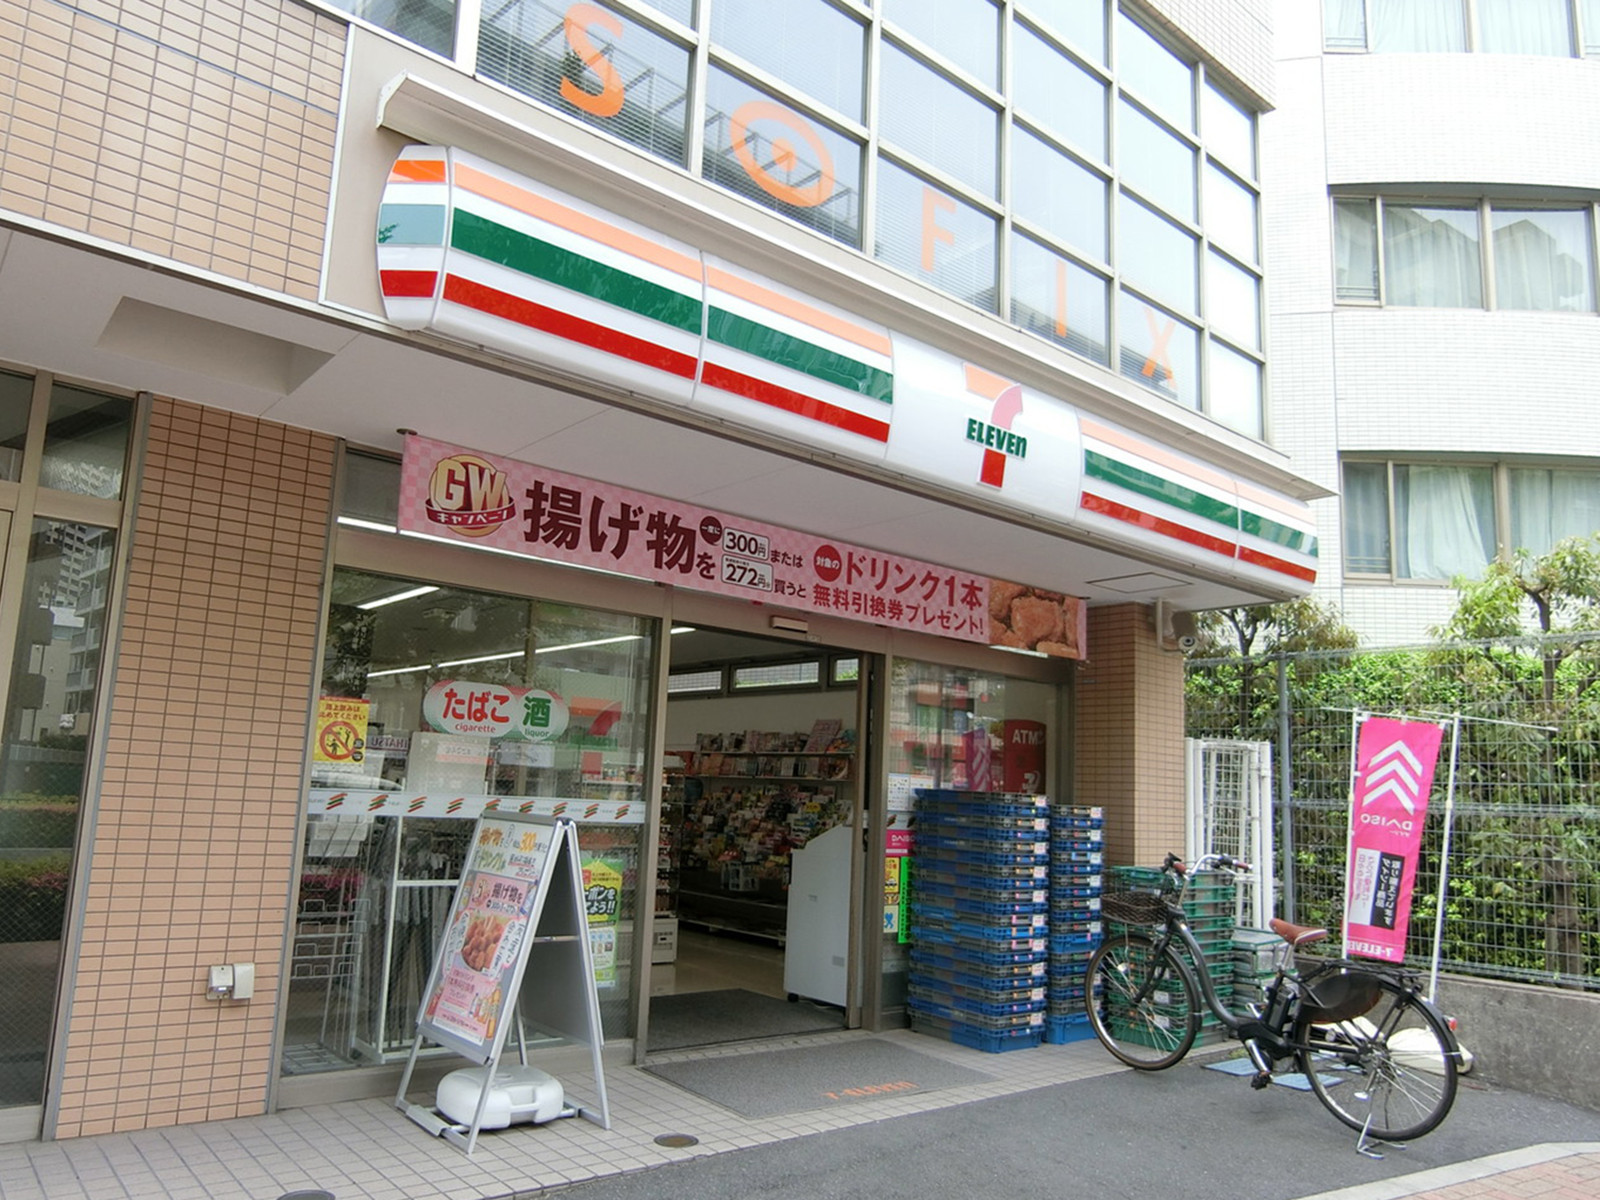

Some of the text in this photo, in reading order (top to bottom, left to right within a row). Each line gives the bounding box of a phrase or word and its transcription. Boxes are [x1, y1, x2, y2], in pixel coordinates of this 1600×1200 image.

[434, 459, 507, 512] GW
[437, 510, 508, 524] キャンペーン
[523, 480, 716, 580] 揚げ物を
[725, 531, 766, 558] 300円
[770, 550, 803, 568] または
[774, 579, 806, 598] 買うと
[846, 552, 983, 611] ドリンク1本
[443, 688, 510, 723] たばこ
[522, 696, 551, 728] 酒
[455, 723, 496, 734] cigarette
[524, 729, 549, 738] liquor
[1012, 728, 1038, 745] ATM
